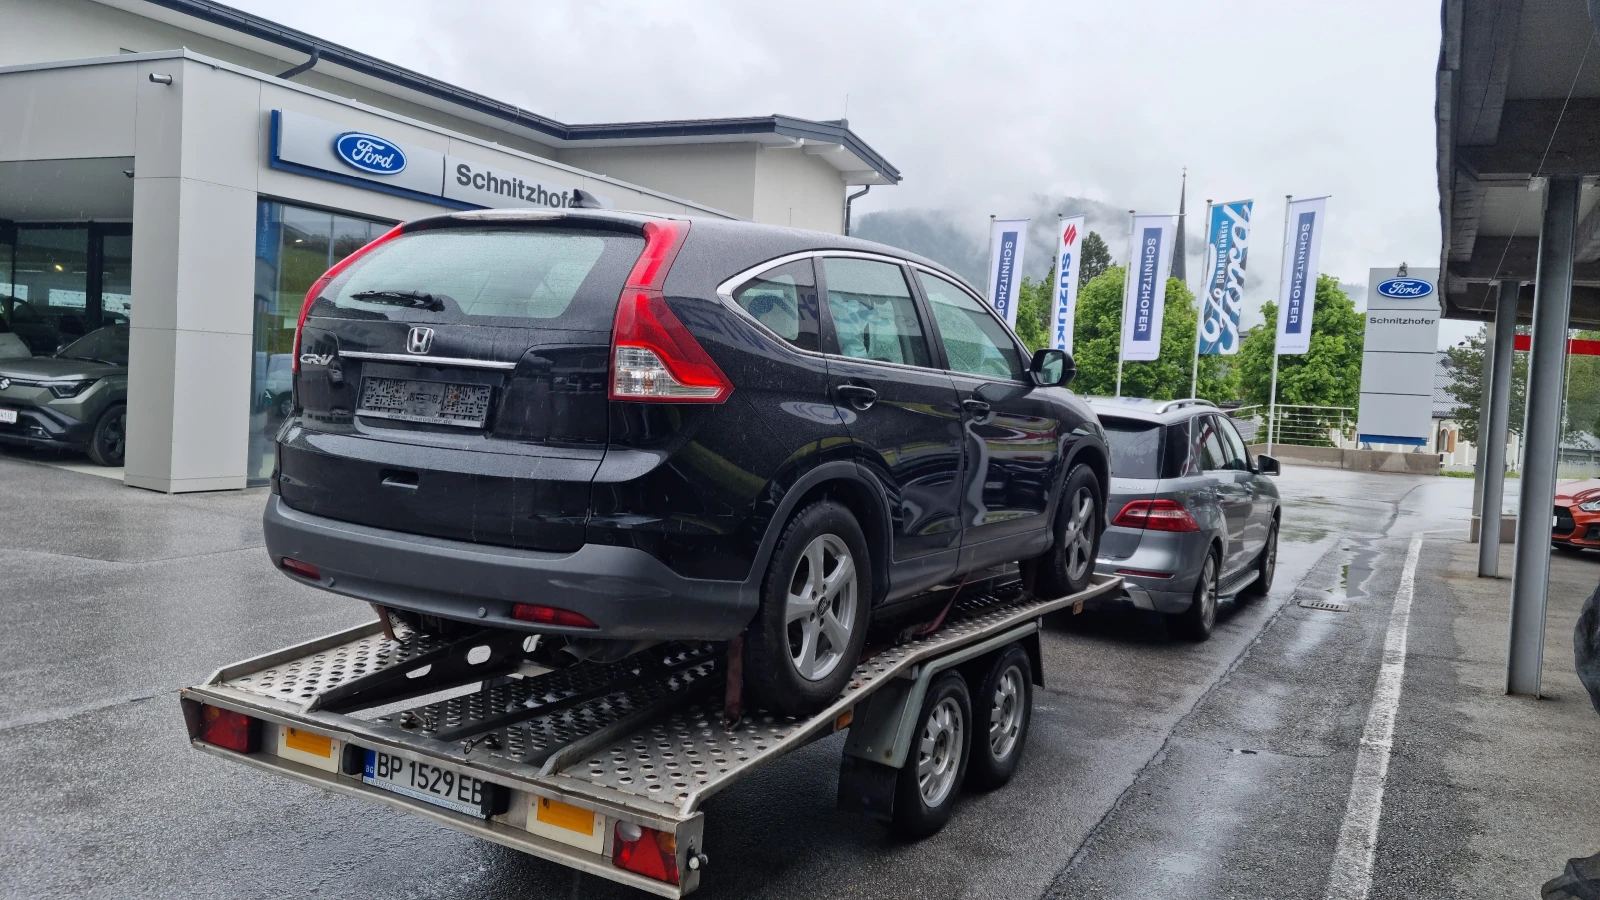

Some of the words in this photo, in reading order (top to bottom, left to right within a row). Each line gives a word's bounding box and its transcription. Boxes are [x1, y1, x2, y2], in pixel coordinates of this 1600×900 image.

[352, 139, 395, 168] Ford
[456, 163, 576, 208] Schnitzhof
[1219, 220, 1229, 248] RANGER
[1217, 250, 1227, 268] NEUE
[1290, 223, 1310, 324] SCHNITZHOFER
[997, 241, 1013, 316] SCHNITZHOF
[1138, 238, 1157, 332] SCHNITZHOFER
[1216, 270, 1225, 284] DER
[1388, 281, 1422, 294] Ford
[1058, 253, 1071, 350] SUZUKI
[1369, 317, 1435, 325] Schnitzhofer
[365, 764, 374, 774] BG
[377, 752, 403, 780] BP
[409, 760, 455, 797] 1529
[457, 772, 482, 806] EB
